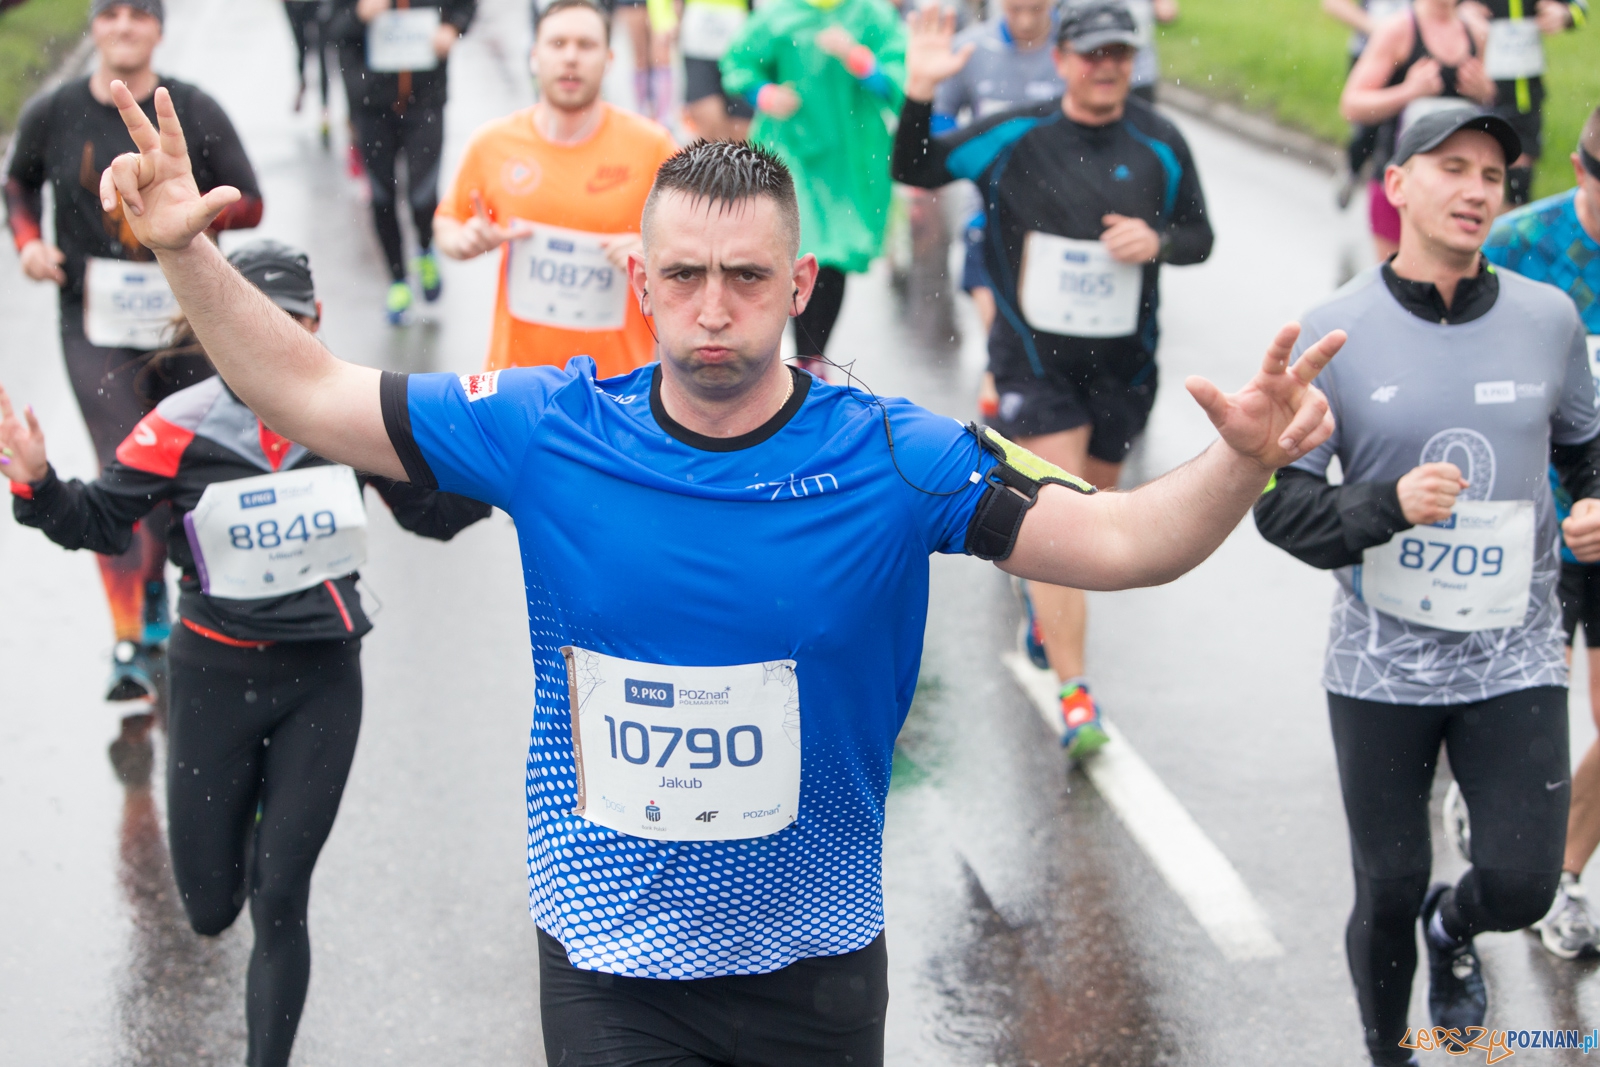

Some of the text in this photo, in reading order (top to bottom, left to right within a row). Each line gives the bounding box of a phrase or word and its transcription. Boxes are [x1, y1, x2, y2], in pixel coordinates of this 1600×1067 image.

[530, 256, 614, 291] 10879
[1370, 384, 1399, 403] 4F
[228, 510, 337, 550] 8849
[1398, 537, 1504, 577] 8709
[604, 714, 764, 770] 10790
[658, 776, 703, 789] Jakub
[694, 810, 720, 823] 4F
